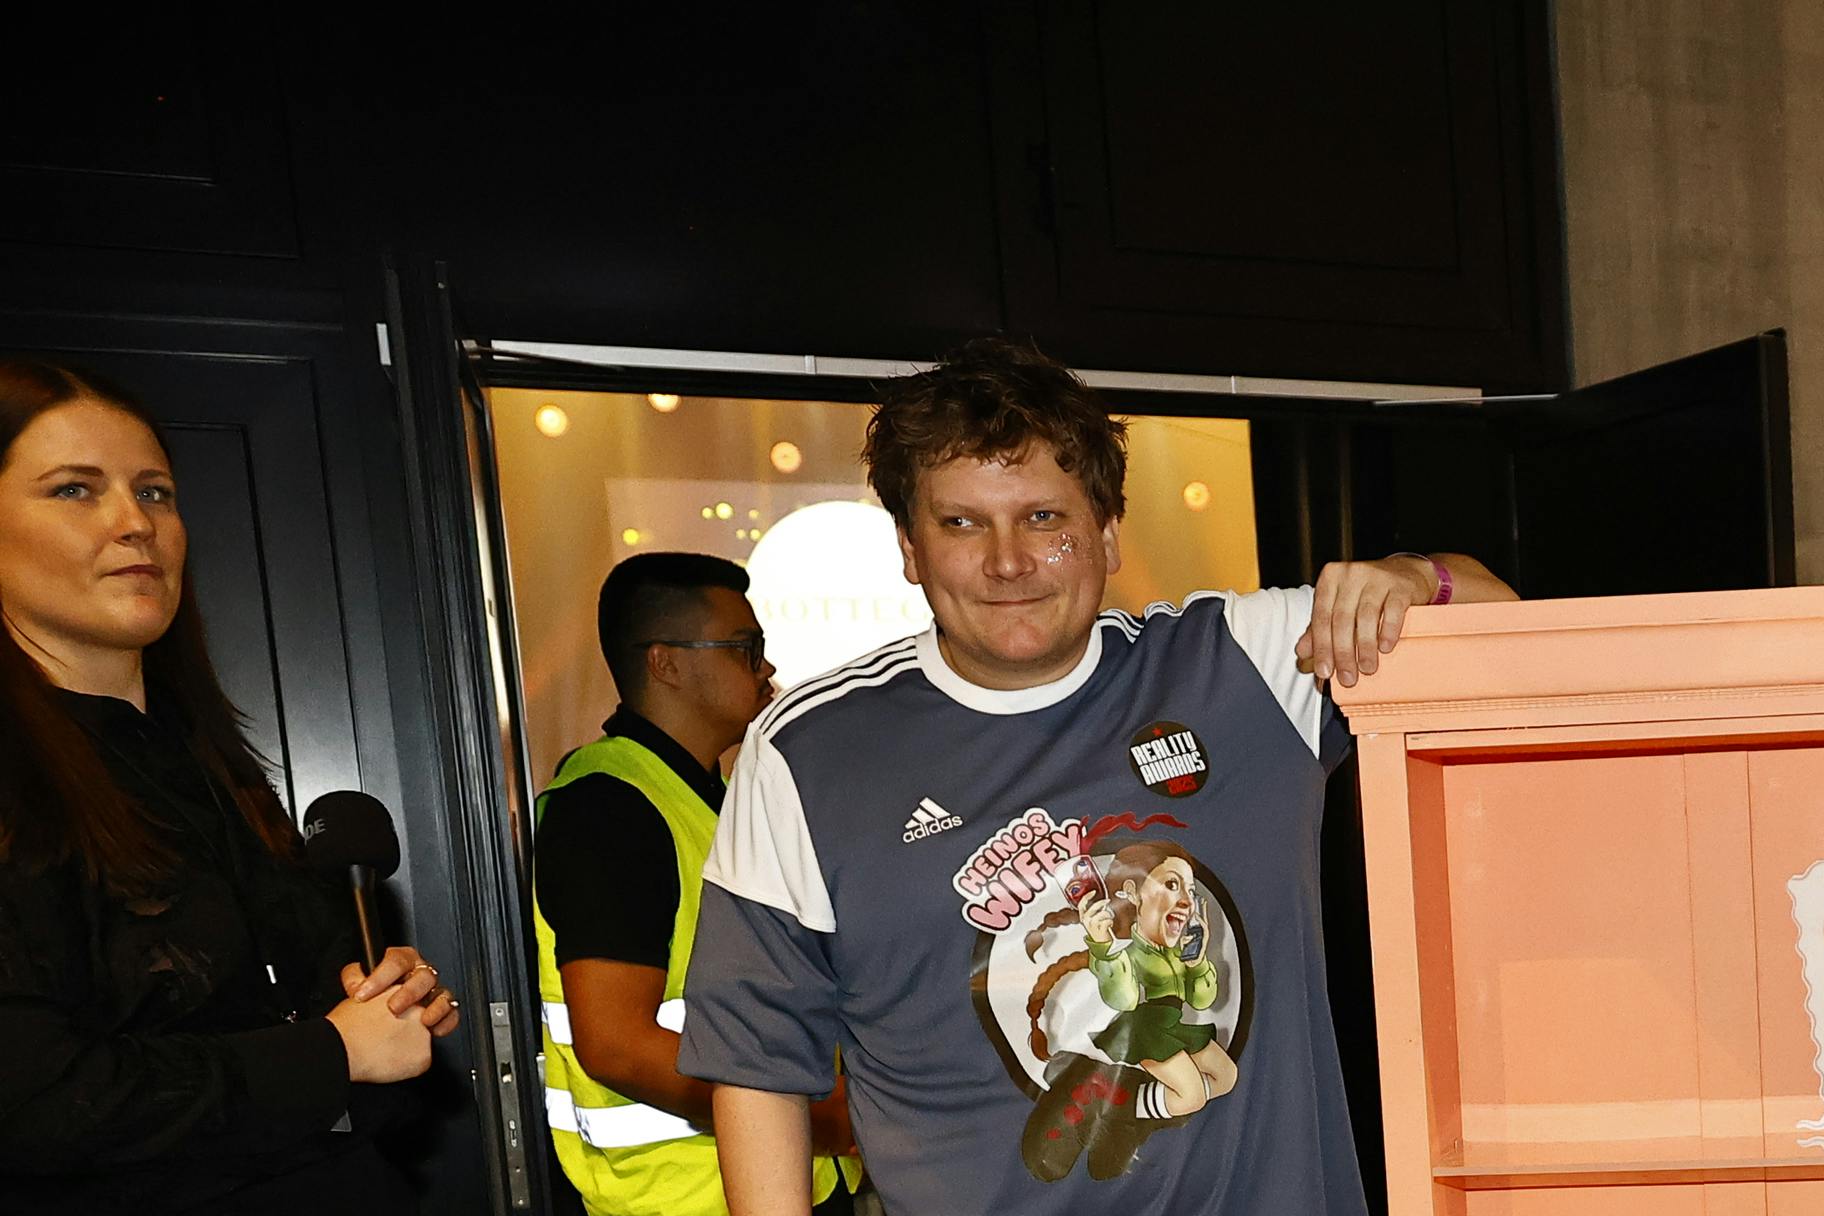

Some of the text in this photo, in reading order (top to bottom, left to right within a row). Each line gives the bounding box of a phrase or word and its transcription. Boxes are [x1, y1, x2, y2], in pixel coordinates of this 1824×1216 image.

[1130, 730, 1197, 766] REALITY
[1139, 750, 1206, 786] AWARDS
[902, 815, 963, 843] adidas
[958, 812, 1050, 896] HEINOS
[967, 823, 1082, 932] WIFEY
